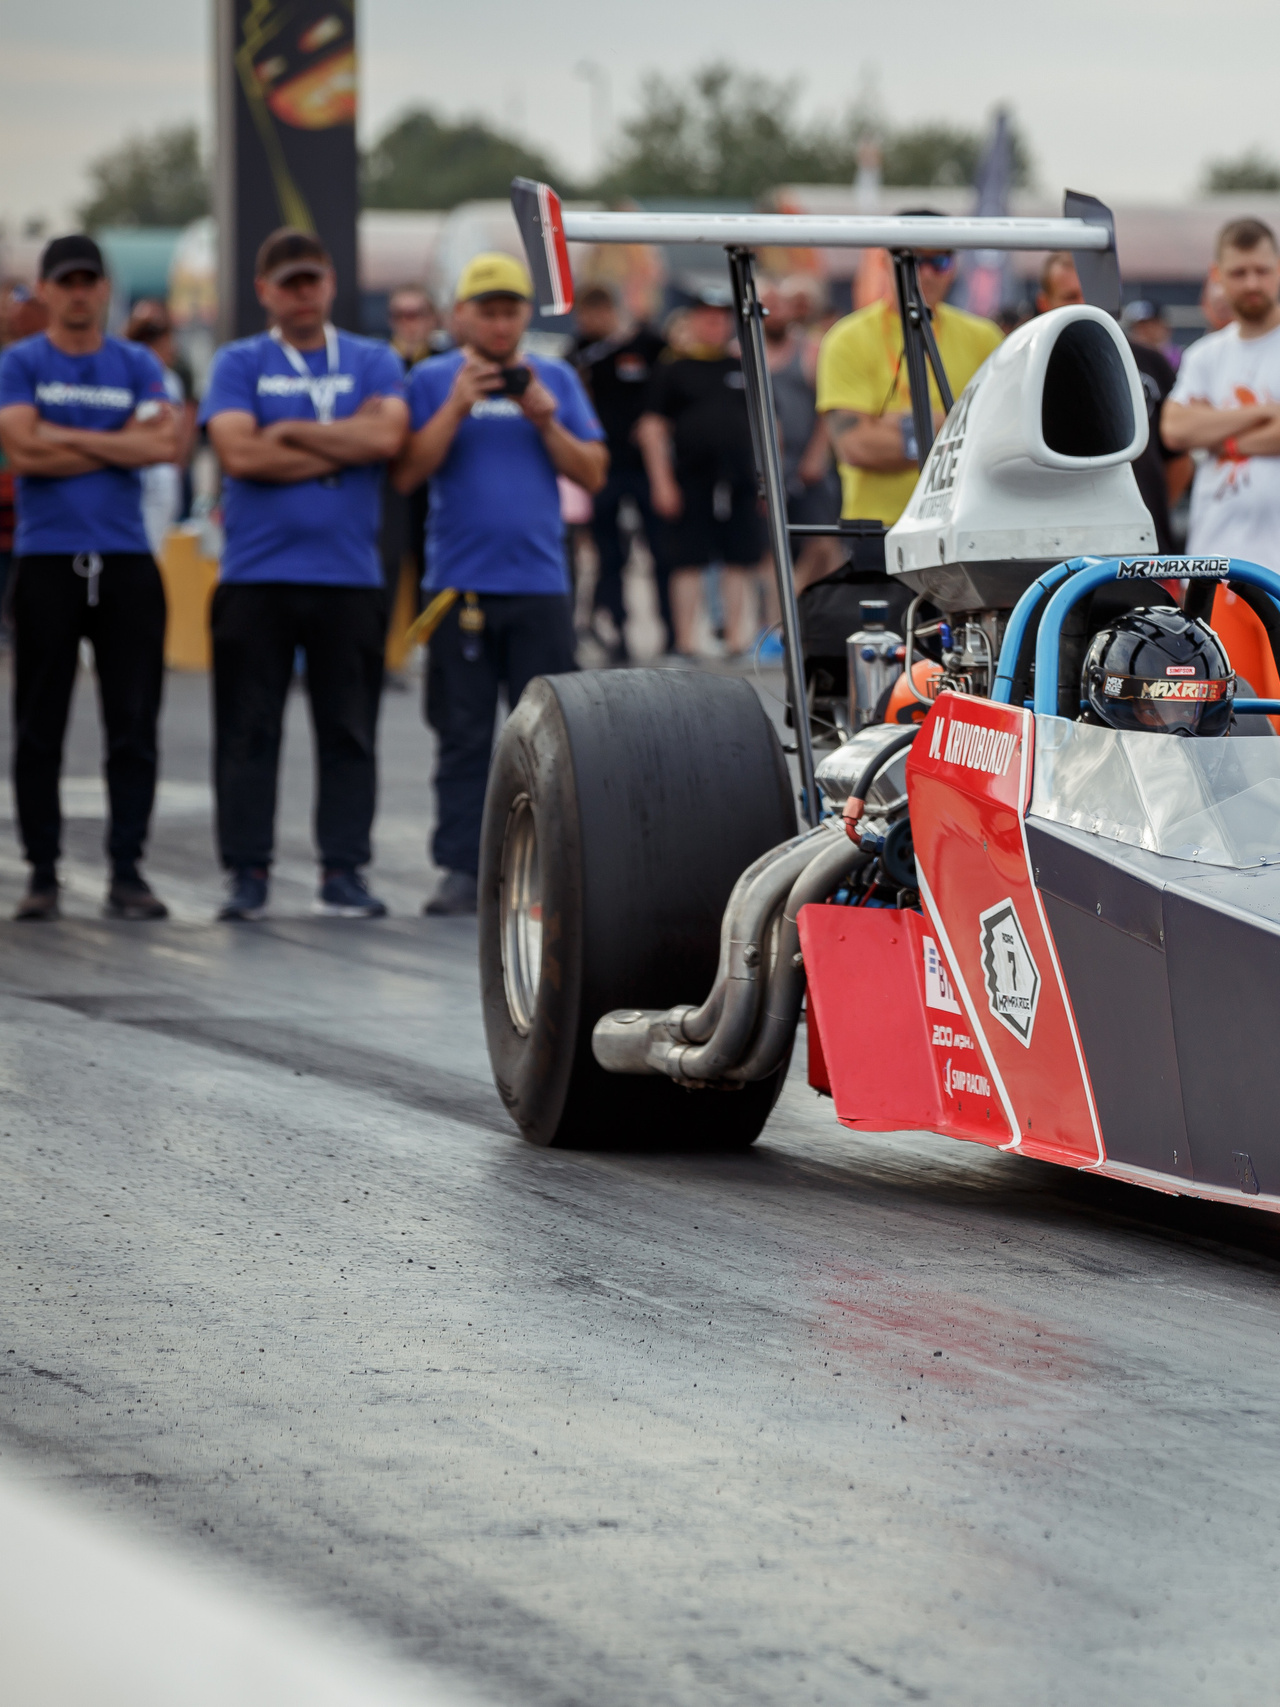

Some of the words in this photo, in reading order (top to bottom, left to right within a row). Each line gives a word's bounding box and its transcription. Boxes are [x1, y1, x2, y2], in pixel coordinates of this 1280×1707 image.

[943, 719, 1018, 777] KRIVOBOKOV
[931, 1024, 953, 1048] 200
[951, 1069, 966, 1091] SMP
[966, 1071, 991, 1097] RACING
